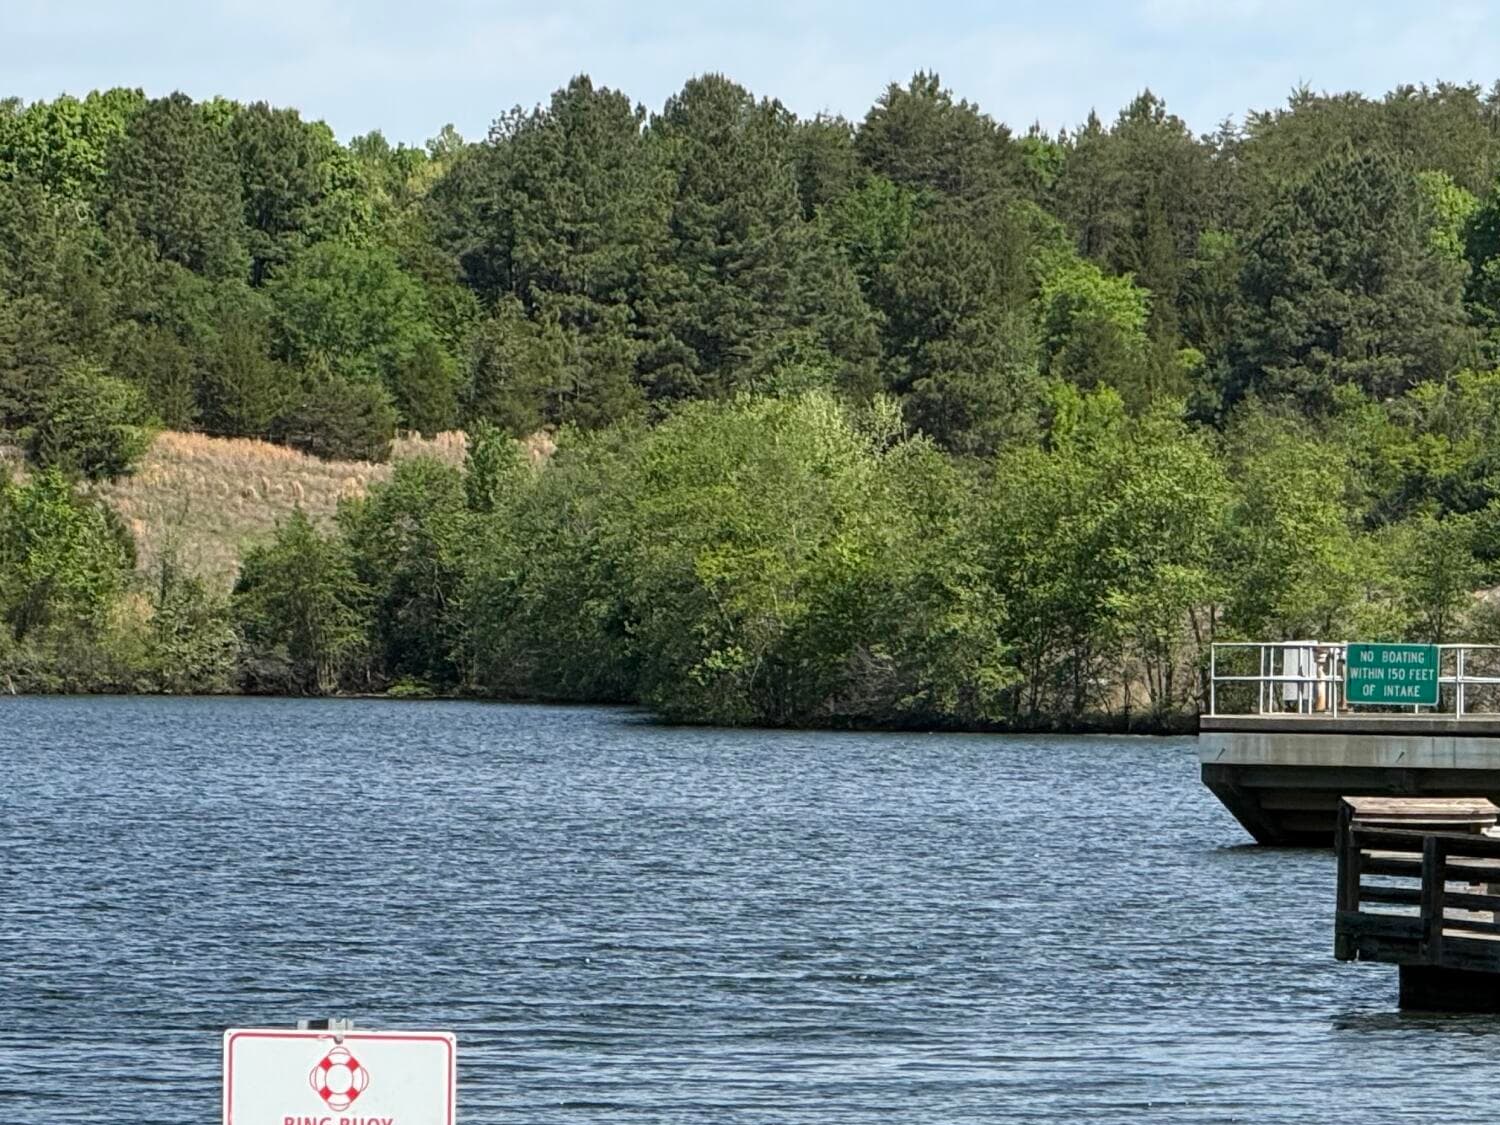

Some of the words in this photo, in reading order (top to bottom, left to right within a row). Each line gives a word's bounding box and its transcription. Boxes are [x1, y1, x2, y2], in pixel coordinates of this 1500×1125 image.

[1360, 650, 1374, 662] NO
[1382, 651, 1425, 664] BOATING
[1350, 667, 1384, 679] WITHIN
[1388, 668, 1405, 680] 150
[1409, 669, 1434, 681] FEET
[1362, 684, 1376, 696] OF
[1383, 685, 1420, 697] INTAKE
